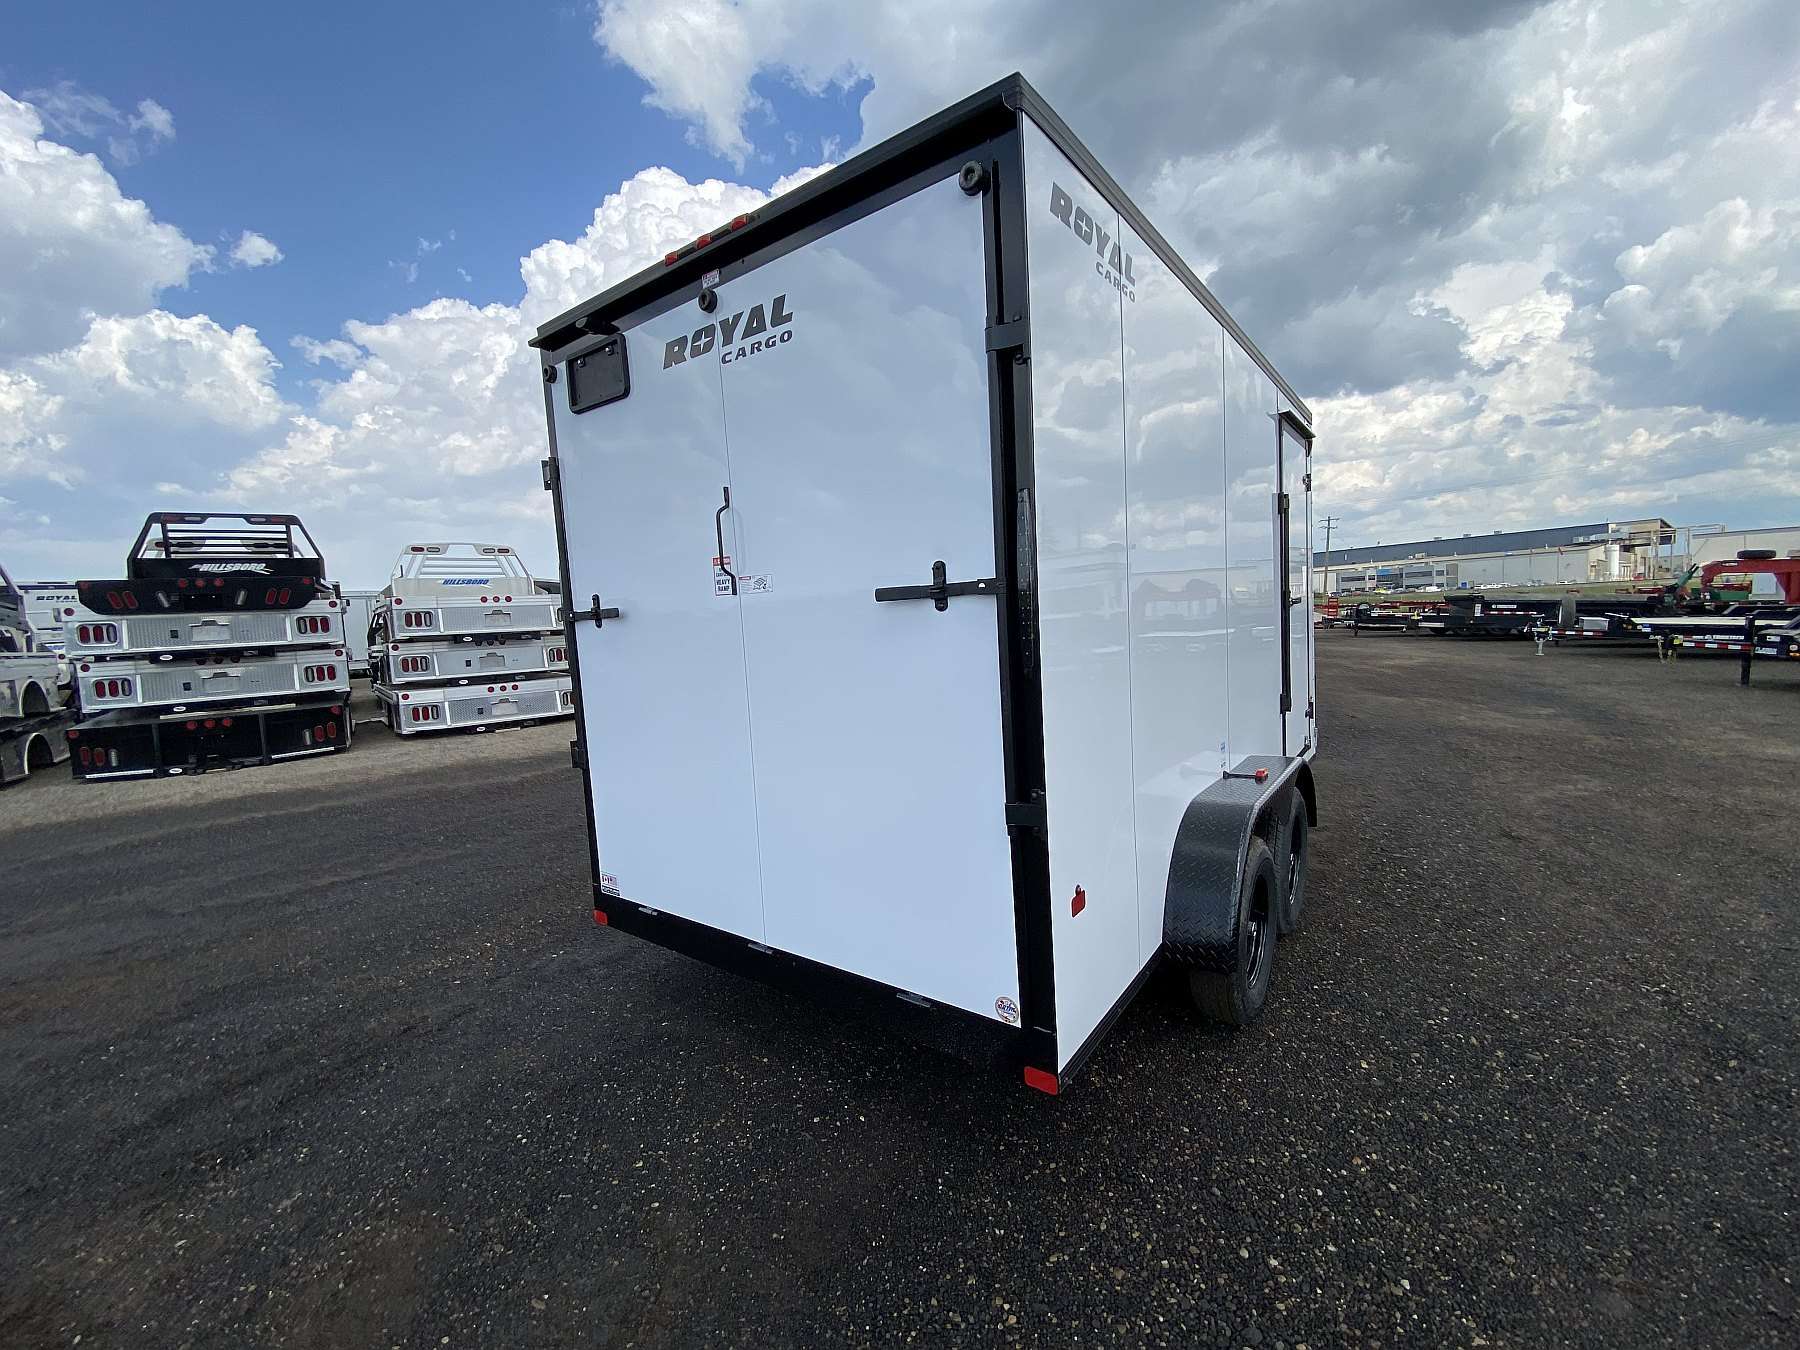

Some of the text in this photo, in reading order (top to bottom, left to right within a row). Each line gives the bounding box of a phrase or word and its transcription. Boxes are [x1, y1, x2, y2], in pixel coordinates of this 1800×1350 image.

[1050, 182, 1136, 287] ROYAL
[1096, 261, 1136, 303] CARGO
[663, 293, 794, 370] ROYAL
[721, 329, 793, 365] CARGO
[199, 563, 266, 572] HILLSBORO
